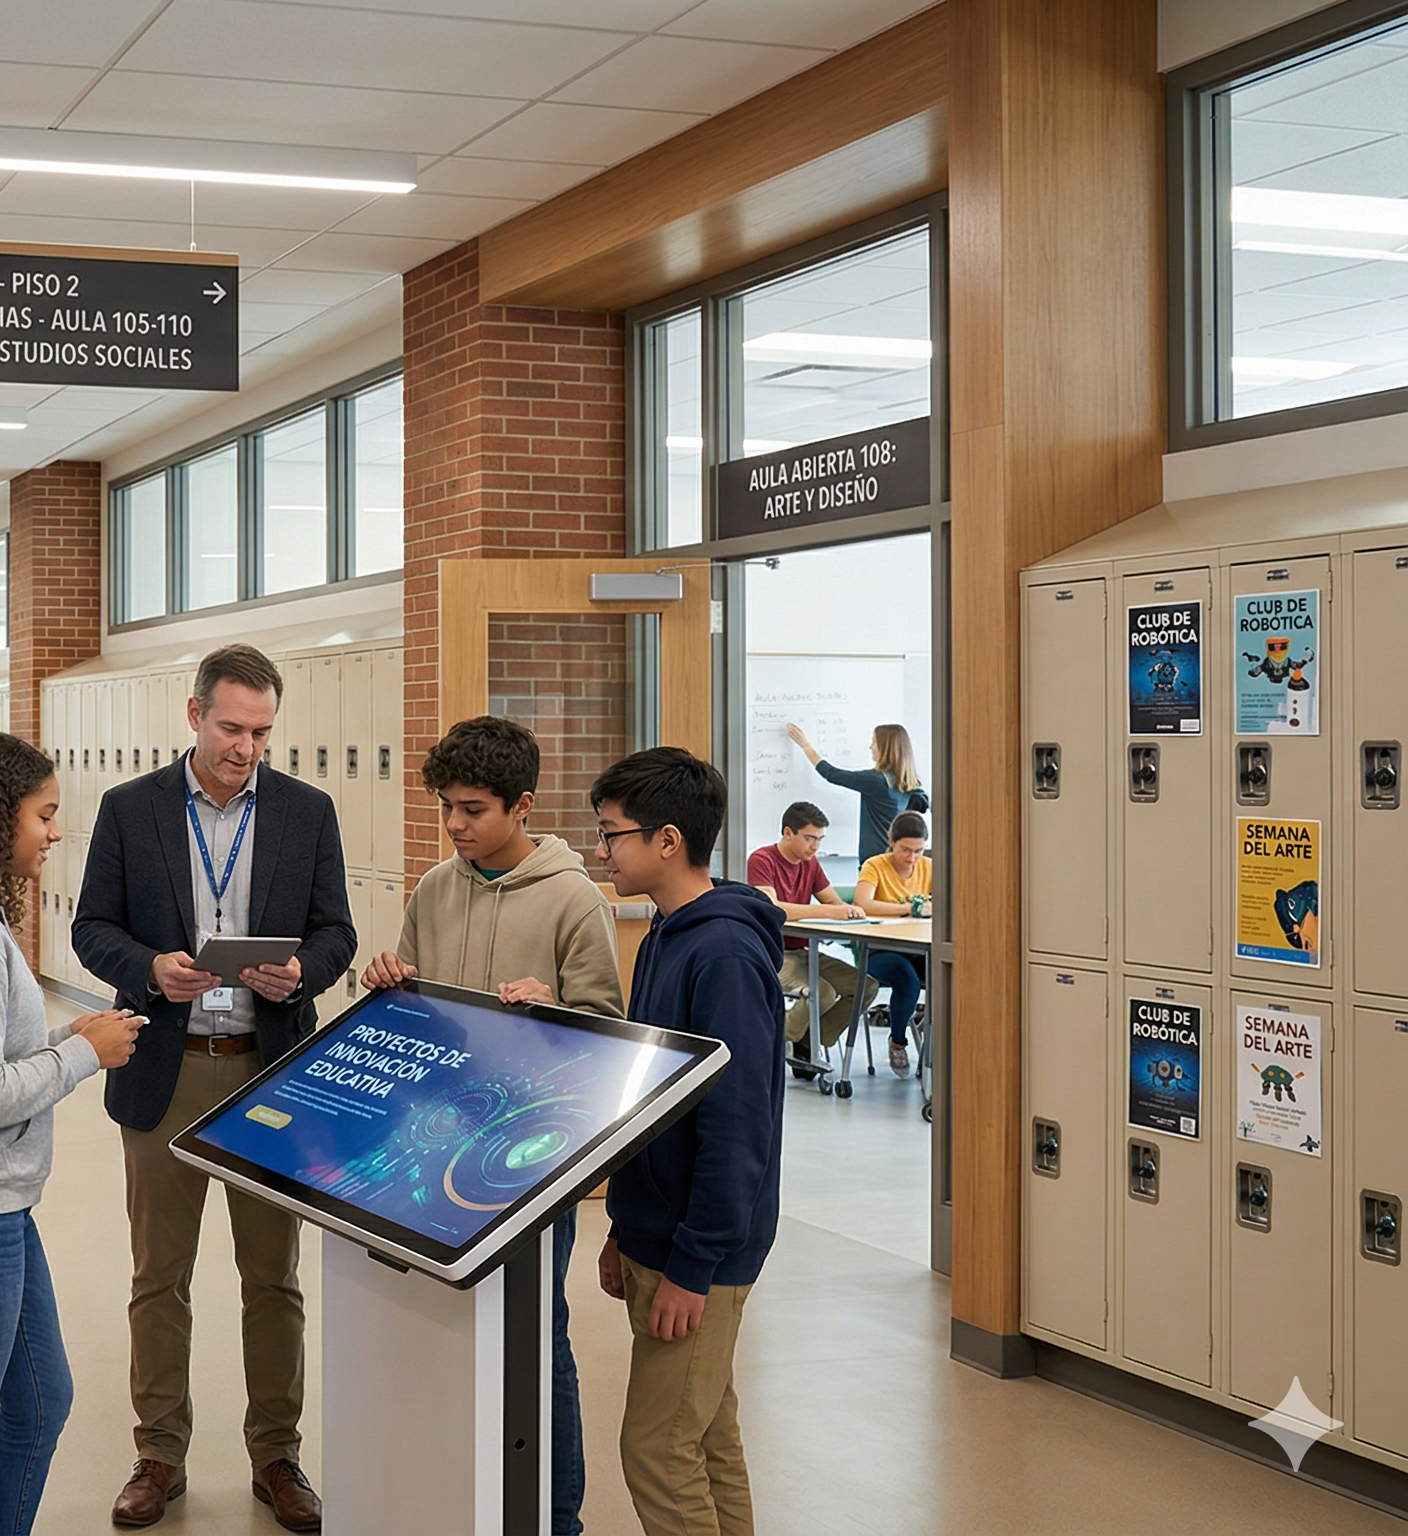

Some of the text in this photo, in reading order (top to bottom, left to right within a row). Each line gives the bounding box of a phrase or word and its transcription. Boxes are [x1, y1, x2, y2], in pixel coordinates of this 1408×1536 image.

[12, 272, 60, 296] PISO
[66, 275, 79, 297] 2
[51, 308, 106, 332] AULA
[112, 311, 192, 336] 105-110
[94, 344, 192, 370] SOCIALES
[749, 440, 897, 492] AULA ABIERTA 108:
[764, 473, 878, 519] ARTE Y DISEÑO
[1247, 597, 1307, 615] CLUB DE
[1137, 611, 1191, 629] CLUB DE
[1131, 626, 1198, 646] ROBÓTICA
[1246, 823, 1311, 842] SEMANA
[1244, 841, 1312, 859] DEL ARTE
[1138, 1005, 1191, 1026] CLUB DE
[1245, 1015, 1310, 1040] SEMANA
[347, 1024, 472, 1069] PROYECTOS DE
[1133, 1022, 1198, 1046] ROBÓTICA
[1244, 1033, 1313, 1059] DEL ARTE
[324, 1041, 431, 1083] INNOVACIÓN
[304, 1060, 395, 1099] EDUCATIVA
